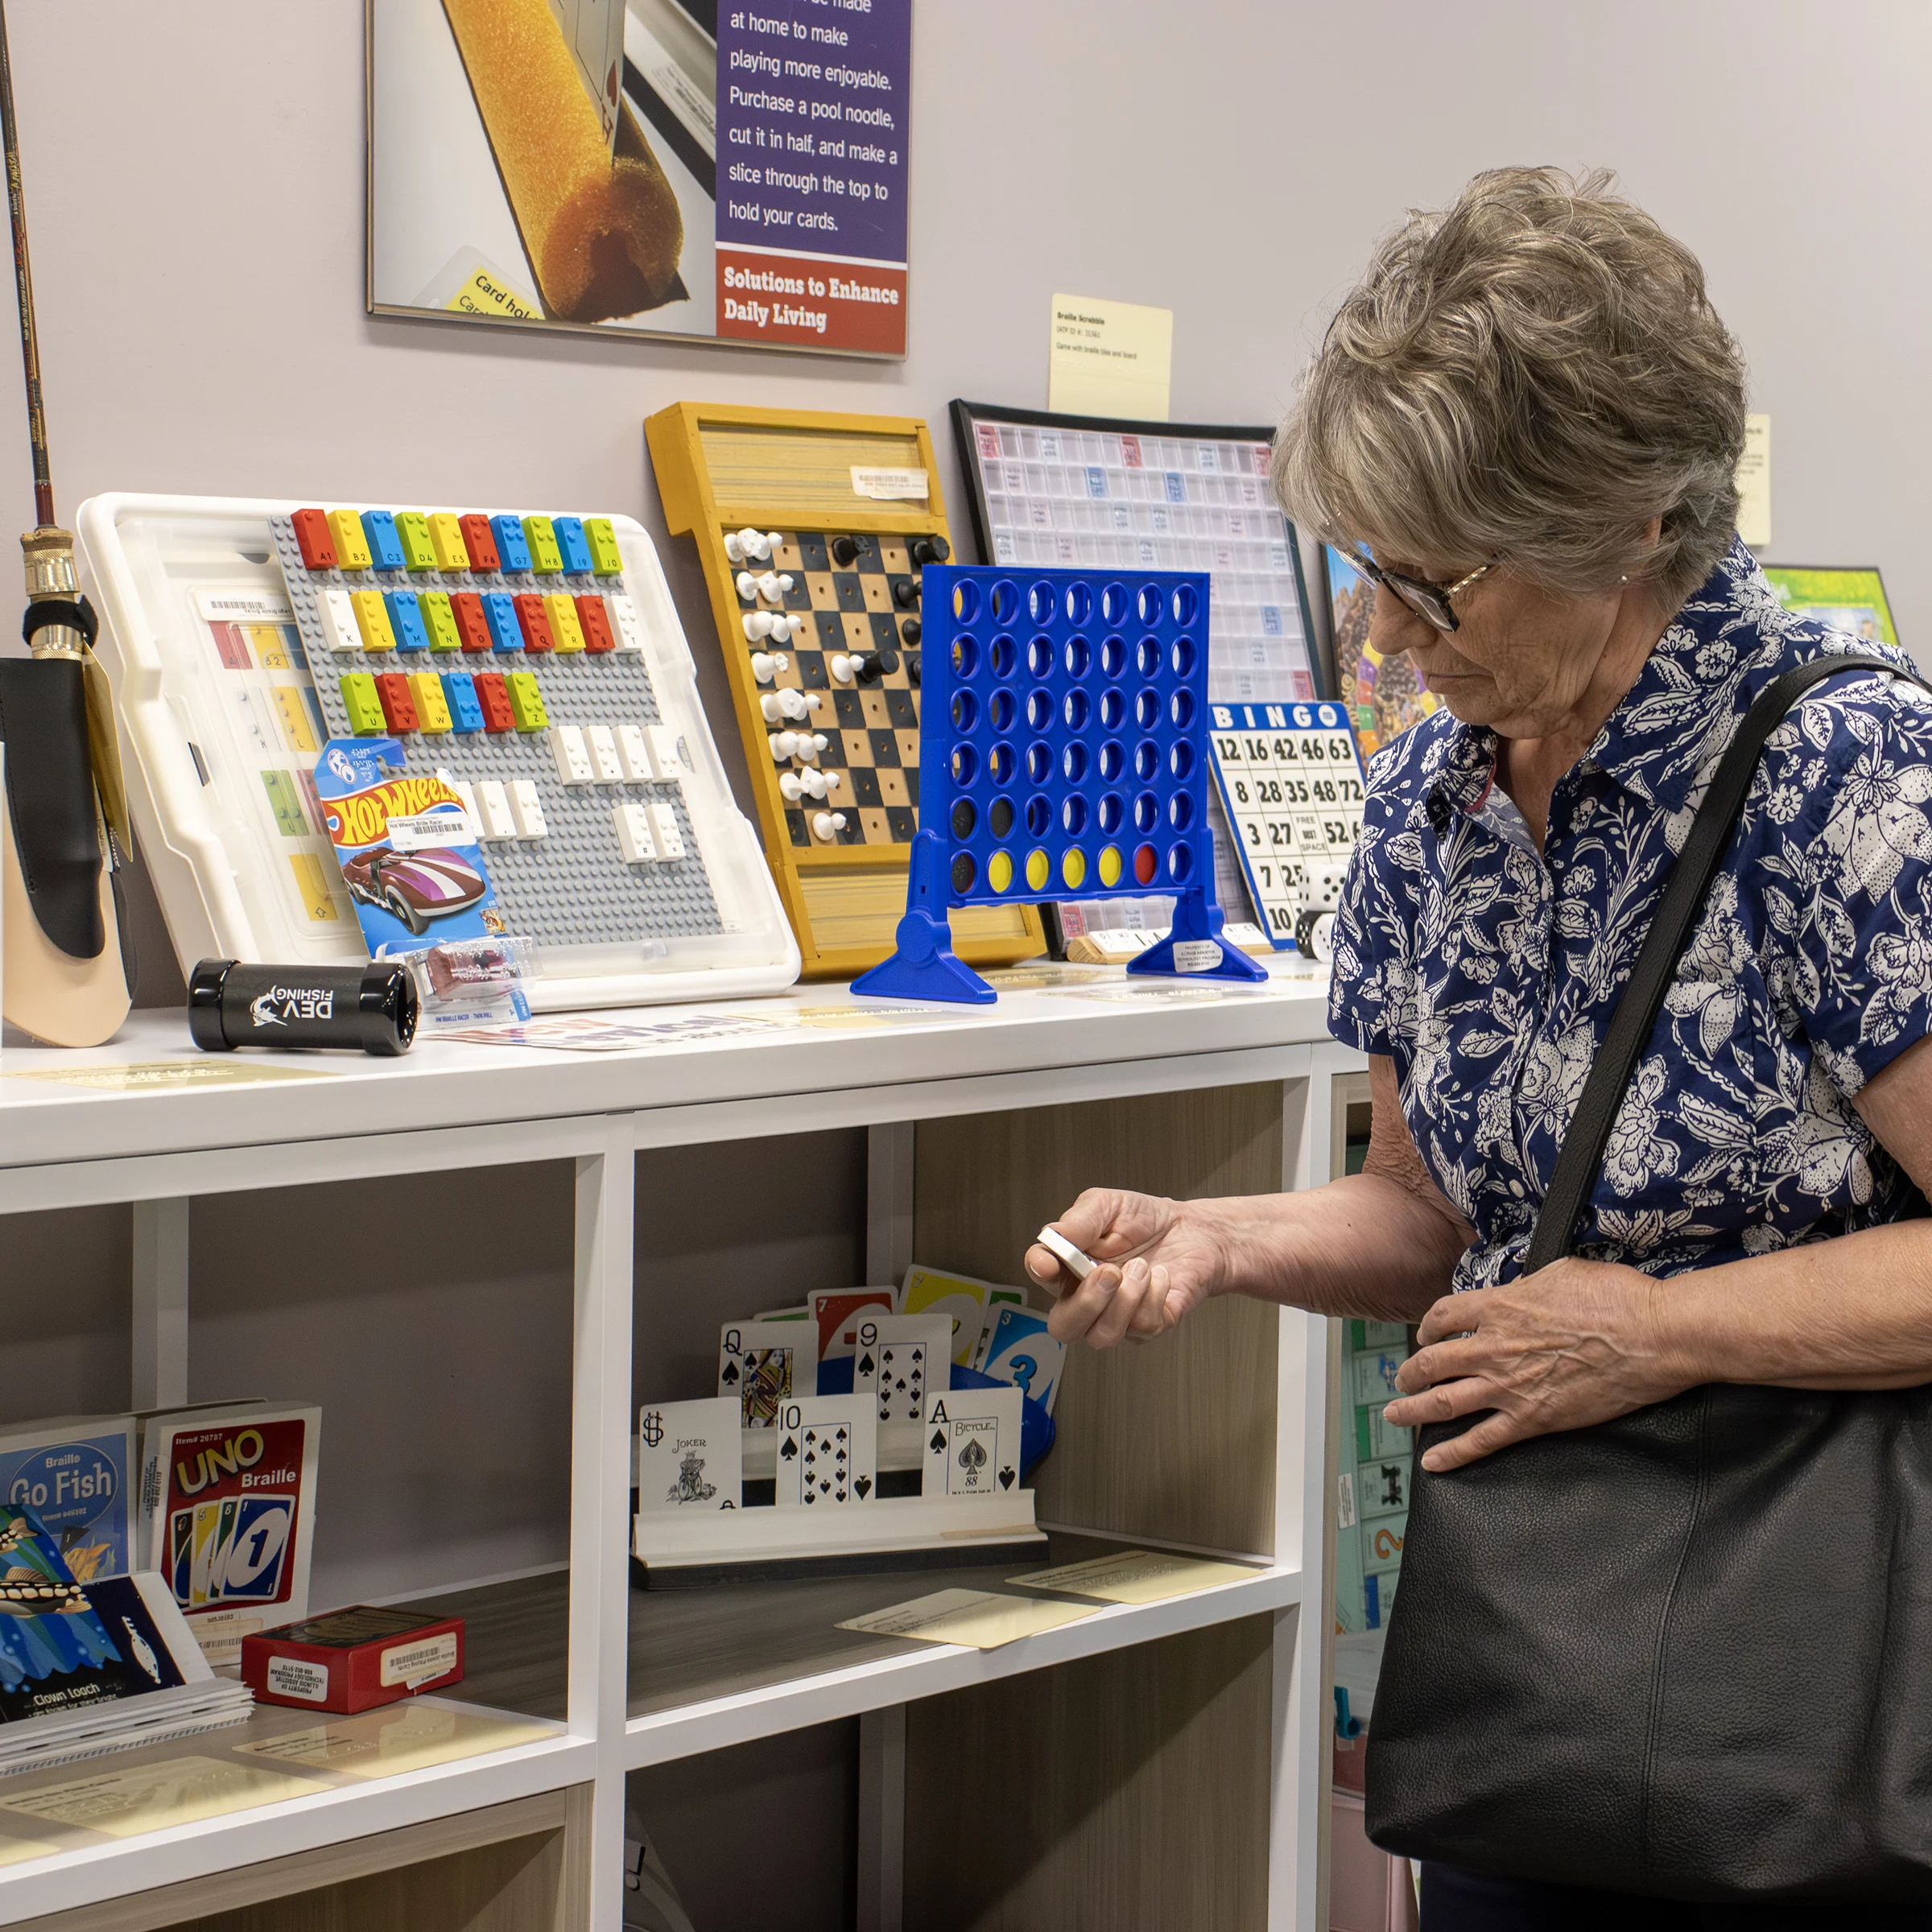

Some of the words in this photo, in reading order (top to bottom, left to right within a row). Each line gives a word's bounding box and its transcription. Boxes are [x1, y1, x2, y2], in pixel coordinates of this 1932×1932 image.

[730, 12, 745, 30] at
[749, 13, 789, 36] home
[792, 21, 807, 39] to
[811, 27, 848, 47] make
[730, 49, 781, 78] playing
[785, 60, 821, 80] more
[825, 65, 892, 91] enjoyable.
[730, 85, 794, 114] Purchase
[798, 100, 807, 115] a
[811, 101, 842, 121] pool
[845, 105, 895, 130] noodle,
[729, 127, 751, 146] cut
[755, 127, 765, 147] it
[770, 129, 783, 149] in
[786, 132, 816, 156] half,
[819, 138, 844, 159] and
[848, 142, 885, 163] make
[889, 149, 898, 165] a
[729, 163, 762, 184] slice
[765, 167, 818, 195] through
[822, 174, 844, 195] the
[848, 178, 871, 200] top
[874, 182, 889, 200] to
[729, 200, 760, 222] hold
[762, 206, 794, 227] your
[797, 210, 839, 231] cards.
[475, 275, 507, 303] Card
[724, 266, 804, 295] Solutions
[807, 275, 826, 297] to
[828, 278, 899, 304] Enhance
[724, 299, 769, 328] Daily
[773, 303, 828, 333] Living
[1057, 312, 1076, 321] Braille
[1079, 314, 1104, 325] Scrabble
[1056, 341, 1071, 351] Game
[346, 634, 352, 643] K
[382, 634, 387, 642] L
[413, 635, 422, 643] M
[446, 635, 453, 643] N
[510, 635, 516, 644] P
[539, 635, 549, 645] Q
[572, 636, 577, 644] R
[630, 637, 637, 645] T
[370, 718, 377, 726] U
[403, 716, 411, 724] V
[436, 716, 444, 724] W
[469, 716, 477, 724] X
[502, 716, 508, 724] Y
[533, 714, 540, 723] Z
[1217, 738, 1241, 761] 12
[1245, 739, 1268, 761] 16
[1274, 738, 1298, 761] 42
[1301, 738, 1324, 760] 46
[1329, 738, 1352, 760] 63
[1235, 781, 1249, 803] 8
[1257, 781, 1282, 803] 28
[1285, 780, 1309, 803] 35
[1313, 780, 1336, 802] 48
[1338, 779, 1364, 800] 72
[1295, 815, 1315, 825] FREE
[1247, 824, 1261, 845] 3
[1269, 823, 1291, 844] 27
[1324, 821, 1349, 844] 52
[1300, 842, 1327, 852] SPACE
[1260, 865, 1271, 888] 7
[1269, 907, 1292, 931] 10
[276, 989, 334, 1001] FISHING
[283, 1000, 332, 1019] DEV
[913, 1274, 924, 1288] 7
[818, 1298, 828, 1312] 7
[1001, 1312, 1012, 1326] 3
[723, 1329, 742, 1356] Q
[860, 1323, 877, 1347] 9
[1009, 1354, 1038, 1395] 3
[779, 1405, 801, 1430] 10
[929, 1399, 949, 1423] A
[45, 1454, 80, 1468] Braille
[176, 1429, 264, 1496] UNO
[10, 1479, 47, 1506] Go
[56, 1462, 112, 1505] Fish
[242, 1469, 296, 1488] Braille
[965, 1476, 978, 1487] 88
[199, 1510, 206, 1520] 5
[225, 1505, 232, 1515] 8
[248, 1529, 269, 1567] 1
[270, 1669, 294, 1678] PROGRAM
[275, 1675, 299, 1686] ASSISTIVE
[295, 1673, 324, 1684] TECHNOLOGY
[299, 1681, 320, 1689] ILLINOIS
[33, 1690, 67, 1706] Clown
[67, 1682, 101, 1699] Loach
[288, 1686, 313, 1695] PROPERTY
